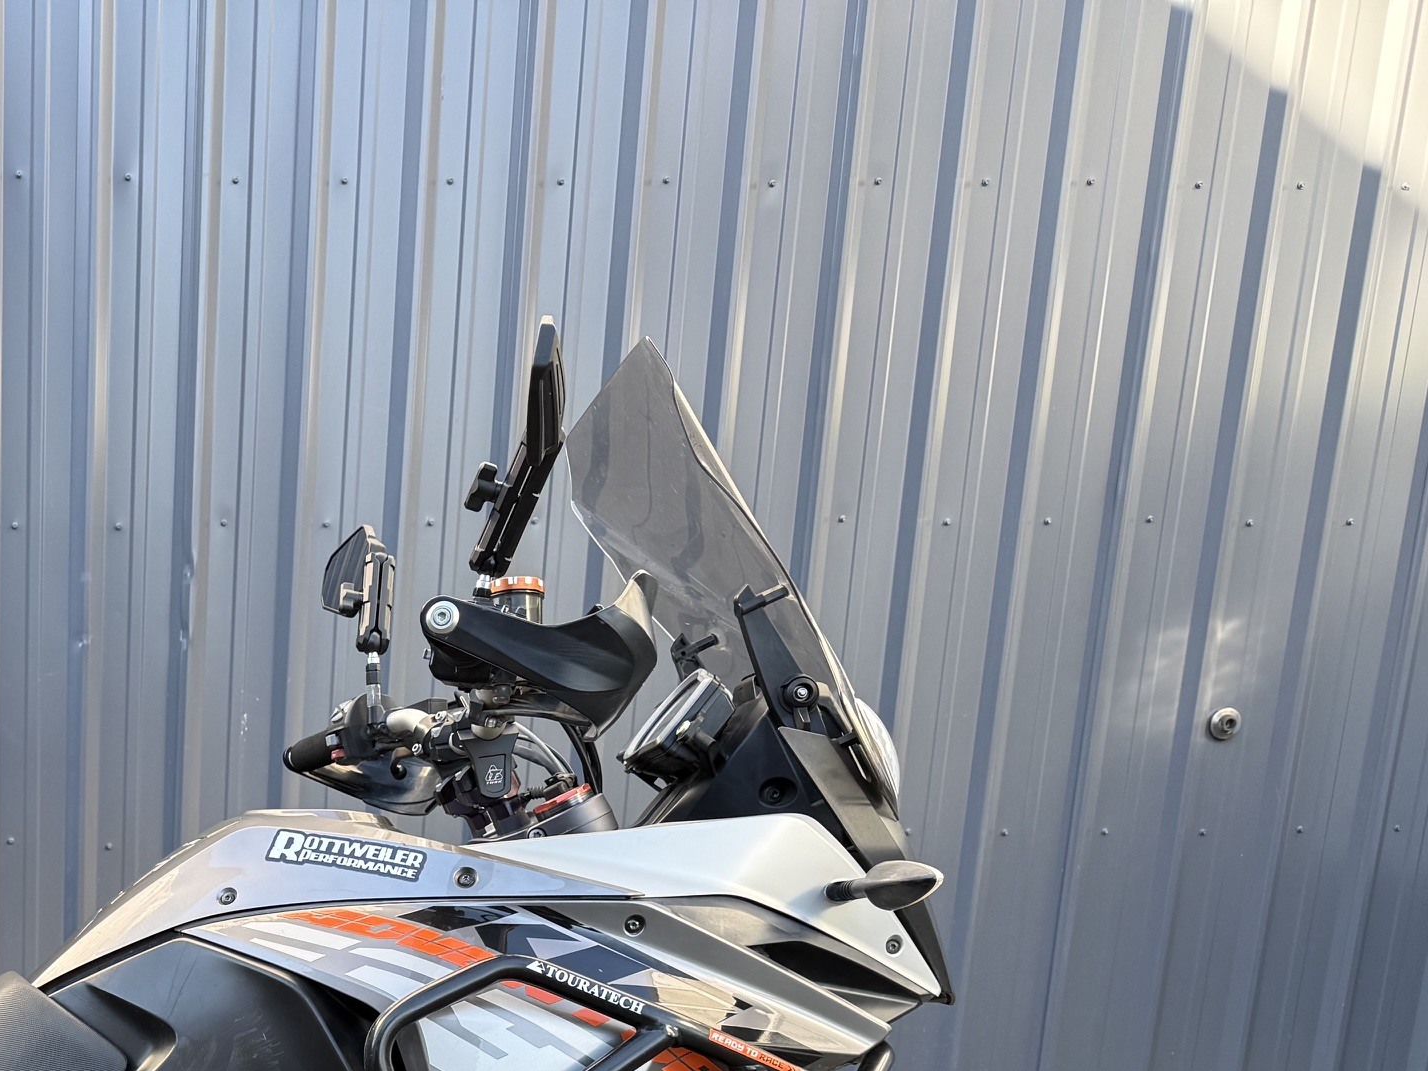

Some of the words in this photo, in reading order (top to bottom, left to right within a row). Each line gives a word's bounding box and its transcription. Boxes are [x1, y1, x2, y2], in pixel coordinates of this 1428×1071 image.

[269, 831, 426, 868] ROTTWEILER
[298, 849, 418, 879] PERFORMANCE
[546, 965, 645, 1015] TOURATECH
[712, 1032, 744, 1052] READY
[746, 1048, 759, 1058] TO
[759, 1053, 785, 1070] RACE
